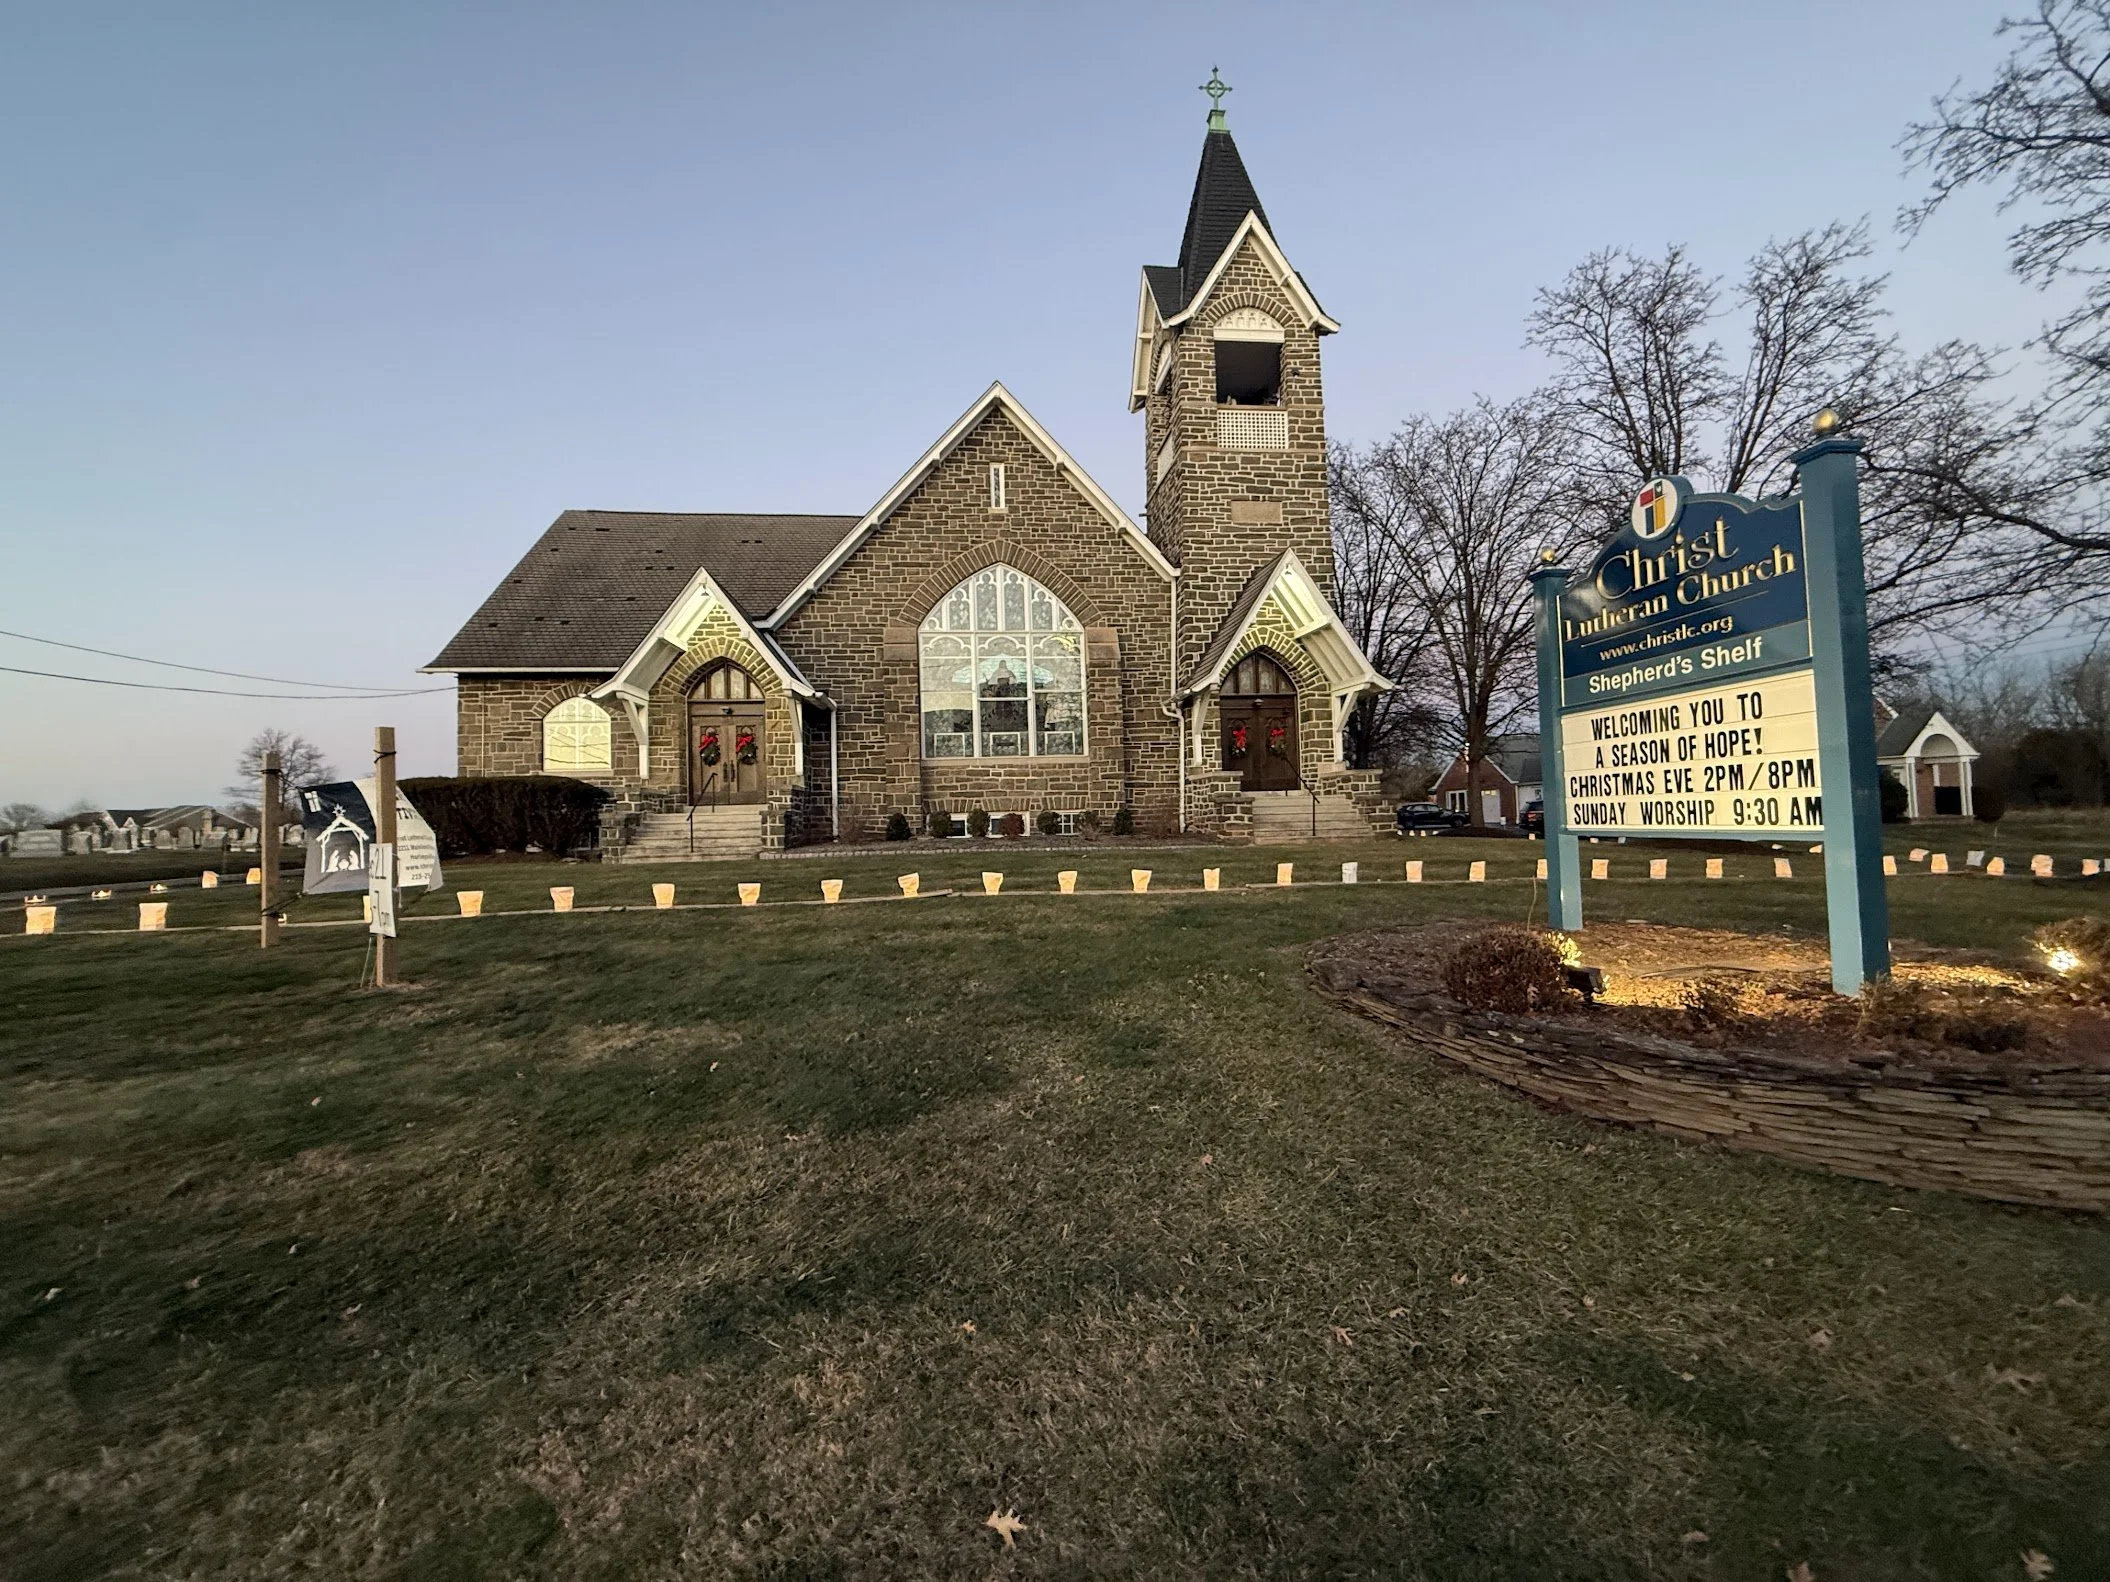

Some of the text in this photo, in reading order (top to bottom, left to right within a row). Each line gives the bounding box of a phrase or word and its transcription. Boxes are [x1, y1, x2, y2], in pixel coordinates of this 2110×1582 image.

[1597, 515, 1739, 600] Christ
[1564, 544, 1797, 641] Lutheran Church
[1600, 616, 1733, 661] www.christlc.org
[1589, 636, 1762, 693] Shepherd's Shelf
[1591, 691, 1762, 741] WELCOMING YOU TO
[1596, 727, 1762, 768] A SEASON OF HOPE!
[1570, 770, 1655, 798] CHRISTMAS
[1664, 768, 1694, 793] EVE
[1574, 796, 1823, 826] SUNDAY WORSHIP 9:30 AM
